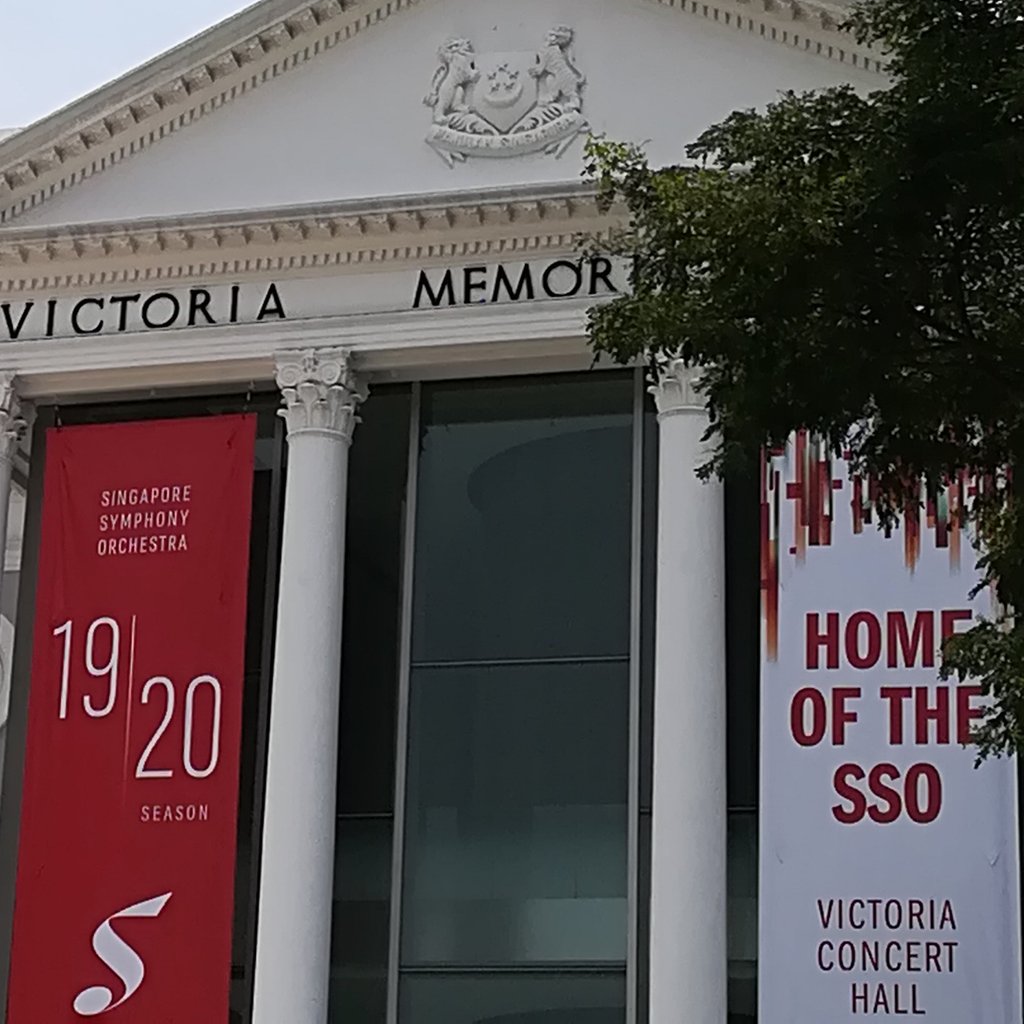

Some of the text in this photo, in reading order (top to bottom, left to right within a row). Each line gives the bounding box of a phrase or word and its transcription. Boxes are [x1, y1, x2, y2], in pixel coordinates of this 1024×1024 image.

[0, 281, 287, 339] VICTORIA
[100, 484, 192, 508] SINGAPORE
[98, 509, 191, 532] SYMPHONY
[96, 534, 188, 556] ORCHESTRA
[790, 686, 984, 747] OF THE
[831, 762, 943, 825] SSO
[140, 804, 209, 822] SEASON
[817, 898, 958, 930] VICTORIA
[817, 941, 959, 973] CONCERT
[851, 983, 927, 1016] HALL
